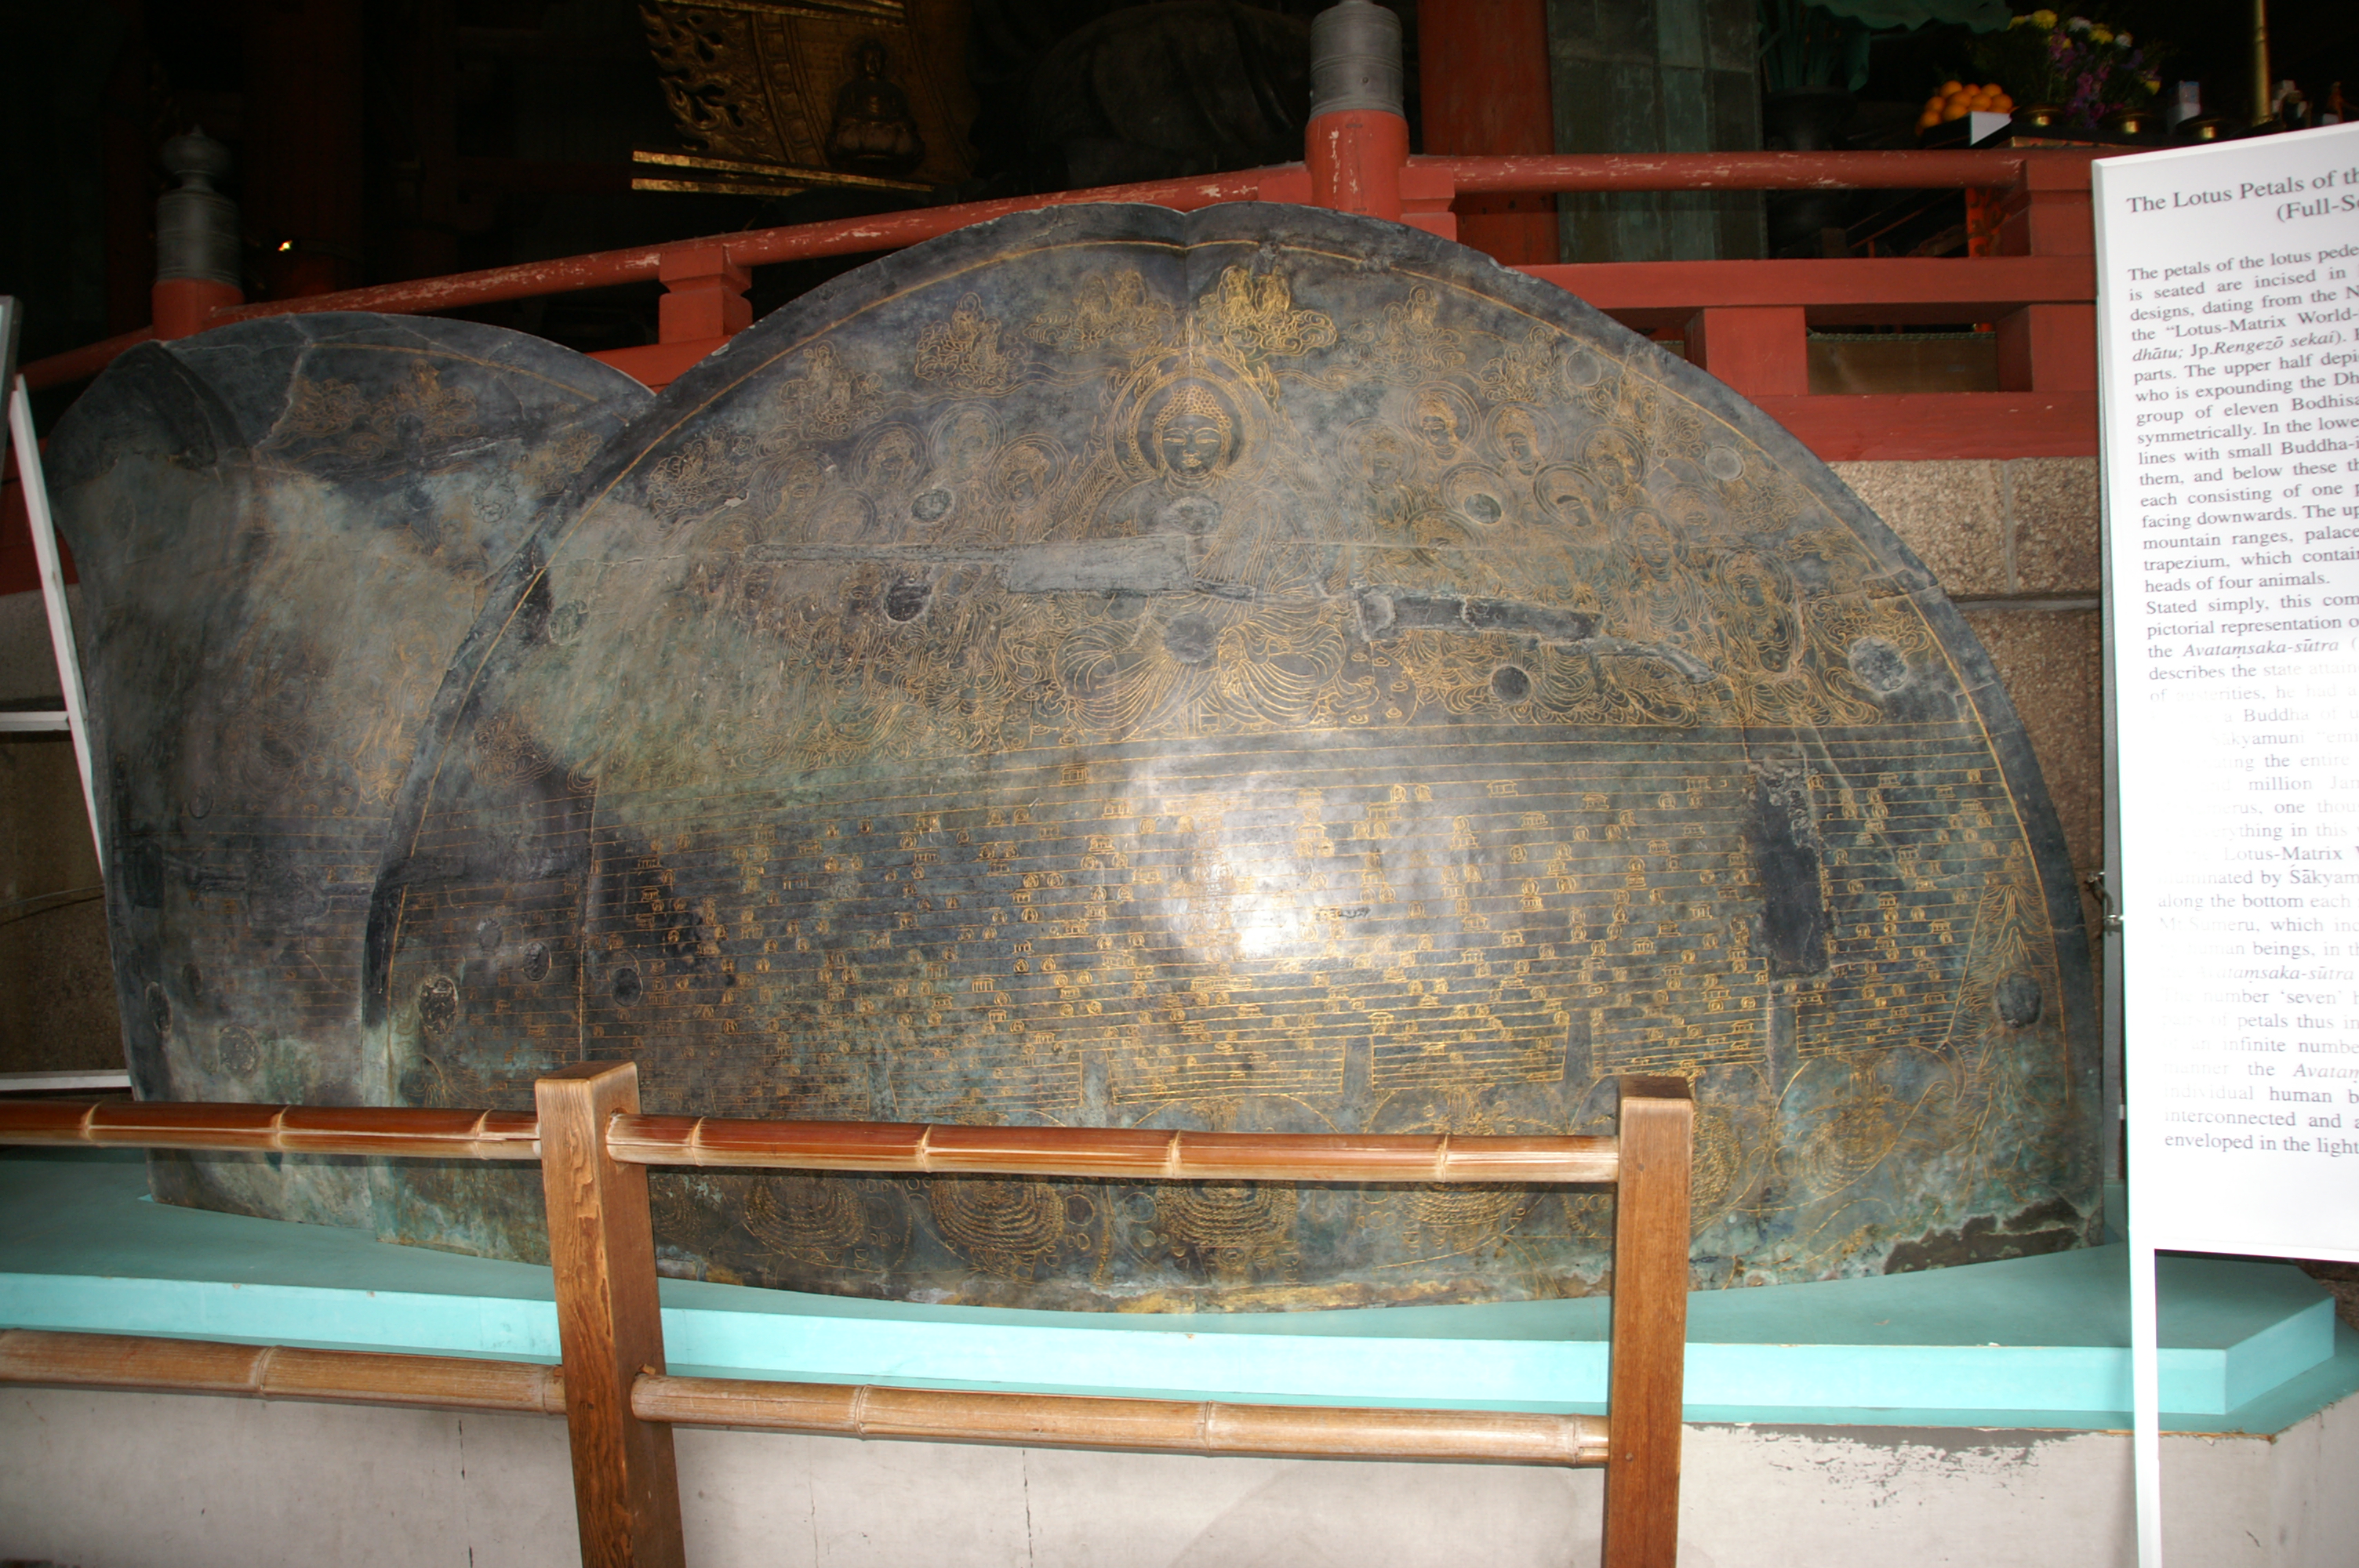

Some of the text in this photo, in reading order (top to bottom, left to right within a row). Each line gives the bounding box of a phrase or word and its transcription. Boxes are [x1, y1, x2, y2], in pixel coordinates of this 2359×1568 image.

[2127, 195, 2166, 214] The
[2173, 189, 2233, 208] Lotus
[2240, 177, 2304, 199] Petals
[2312, 171, 2337, 189] of
[2128, 268, 2158, 281] The
[2165, 262, 2211, 281] petals
[2216, 259, 2234, 272] of
[2240, 256, 2264, 269] the
[2270, 252, 2311, 266] lotus
[2129, 267, 2346, 301] is seated are incised in
[2131, 307, 2195, 322] designs,
[2202, 298, 2253, 314] dating
[2262, 296, 2303, 308] from
[2311, 290, 2337, 303] the
[2132, 328, 2156, 341] the
[2298, 308, 2358, 325] World-
[2290, 331, 2346, 347] sekai).
[2134, 350, 2359, 385] parts. The upper half depi
[2135, 389, 2168, 402] who
[2176, 387, 2189, 399] is
[2196, 379, 2292, 399] expounding
[2301, 376, 2326, 389] the
[2136, 409, 2184, 426] group
[2195, 405, 2214, 419] of
[2224, 402, 2279, 416] eleven
[2138, 424, 2257, 446] symmetrically.
[2263, 422, 2280, 434] In
[2287, 420, 2312, 433] the
[2139, 451, 2175, 465] lines
[2185, 448, 2219, 462] with
[2228, 443, 2273, 459] small
[2140, 472, 2184, 486] them,
[2194, 469, 2223, 482] and
[2234, 465, 2282, 480] below
[2293, 462, 2337, 476] these
[2141, 492, 2177, 507] each
[2188, 488, 2273, 504] consisting
[2283, 483, 2303, 497] of
[2312, 483, 2343, 496] one
[2142, 514, 2191, 529] facing
[2197, 507, 2297, 525] downwards.
[2303, 504, 2336, 518] The
[2143, 532, 2221, 550] mountain
[2232, 531, 2294, 546] ranges,
[2144, 555, 2230, 573] trapezium,
[2241, 550, 2292, 565] which
[2145, 571, 2330, 593] heads of four animals.
[2146, 599, 2197, 615] Stated
[2208, 597, 2270, 614] simply,
[2281, 593, 2312, 608] this
[2147, 620, 2215, 640] pictorial
[2221, 615, 2342, 635] representation
[2148, 644, 2172, 658] the
[2149, 658, 2359, 681] describes the state attain
[2150, 688, 2168, 702] of
[2276, 685, 2295, 698] he
[2244, 708, 2309, 723] Buddha
[2265, 755, 2291, 768] the
[2300, 753, 2350, 767] entire
[2248, 776, 2312, 790] million
[2274, 802, 2305, 814] one
[2291, 823, 2307, 837] in
[2317, 822, 2347, 837] this
[2225, 846, 2343, 862] Lotus-Matrix
[2261, 870, 2282, 887] by
[2158, 894, 2350, 911] along the bottom each
[2270, 917, 2323, 932] which
[2253, 942, 2316, 959] beings,
[2324, 942, 2340, 956] in
[2204, 989, 2270, 1004] number
[2237, 1014, 2288, 1031] petals
[2297, 1014, 2335, 1029] thus
[2223, 1037, 2287, 1052] infinite
[2248, 1062, 2276, 1076] the
[2270, 1087, 2332, 1103] human
[2165, 1109, 2296, 1127] interconnected
[2308, 1114, 2342, 1128] and
[2165, 1133, 2359, 1157] enveloped in the light
